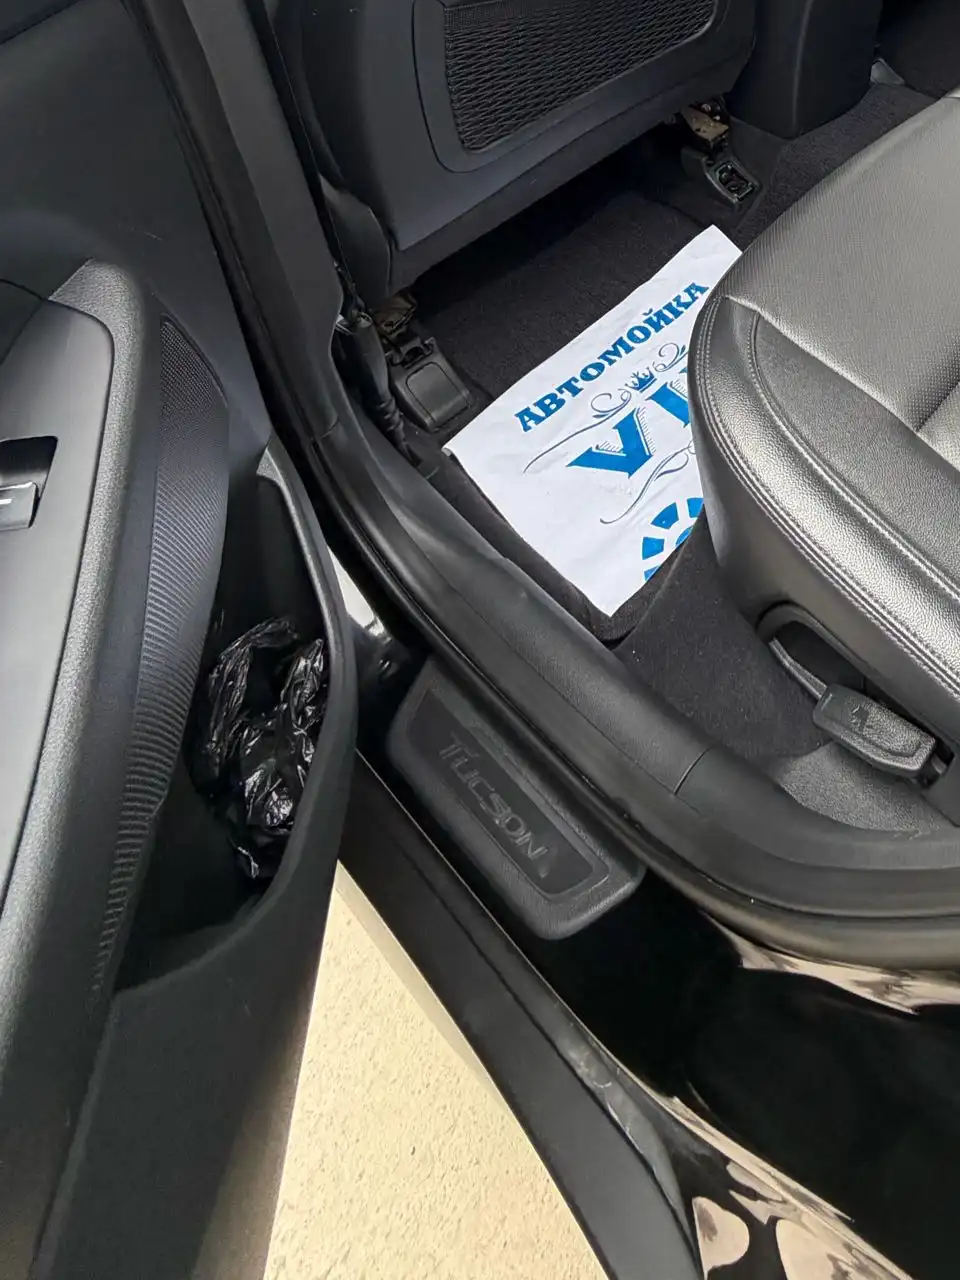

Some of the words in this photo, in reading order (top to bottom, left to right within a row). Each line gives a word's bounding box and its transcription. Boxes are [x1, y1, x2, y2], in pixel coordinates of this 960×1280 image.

[514, 281, 710, 433] АВТОМОЙКА
[565, 367, 692, 479] VI
[439, 732, 548, 860] TUCSON
